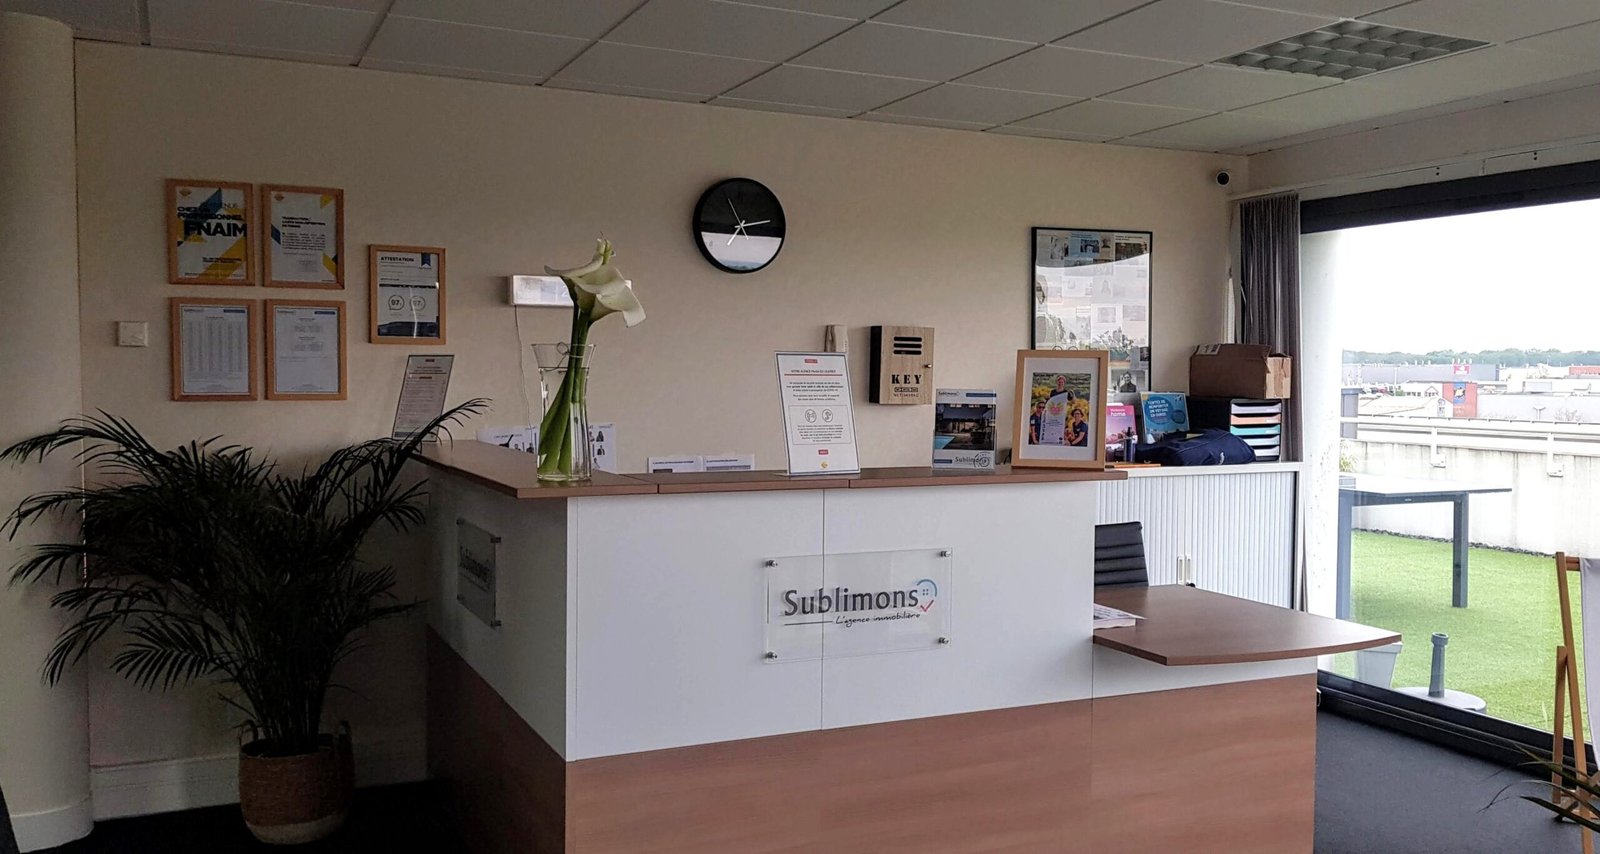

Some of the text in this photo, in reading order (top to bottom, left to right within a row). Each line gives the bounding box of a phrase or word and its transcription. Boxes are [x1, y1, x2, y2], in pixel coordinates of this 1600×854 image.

[184, 222, 248, 237] FNAIM
[891, 374, 922, 384] KEY
[784, 586, 919, 616] Sublimons
[835, 611, 920, 627] L'agence immobilière
